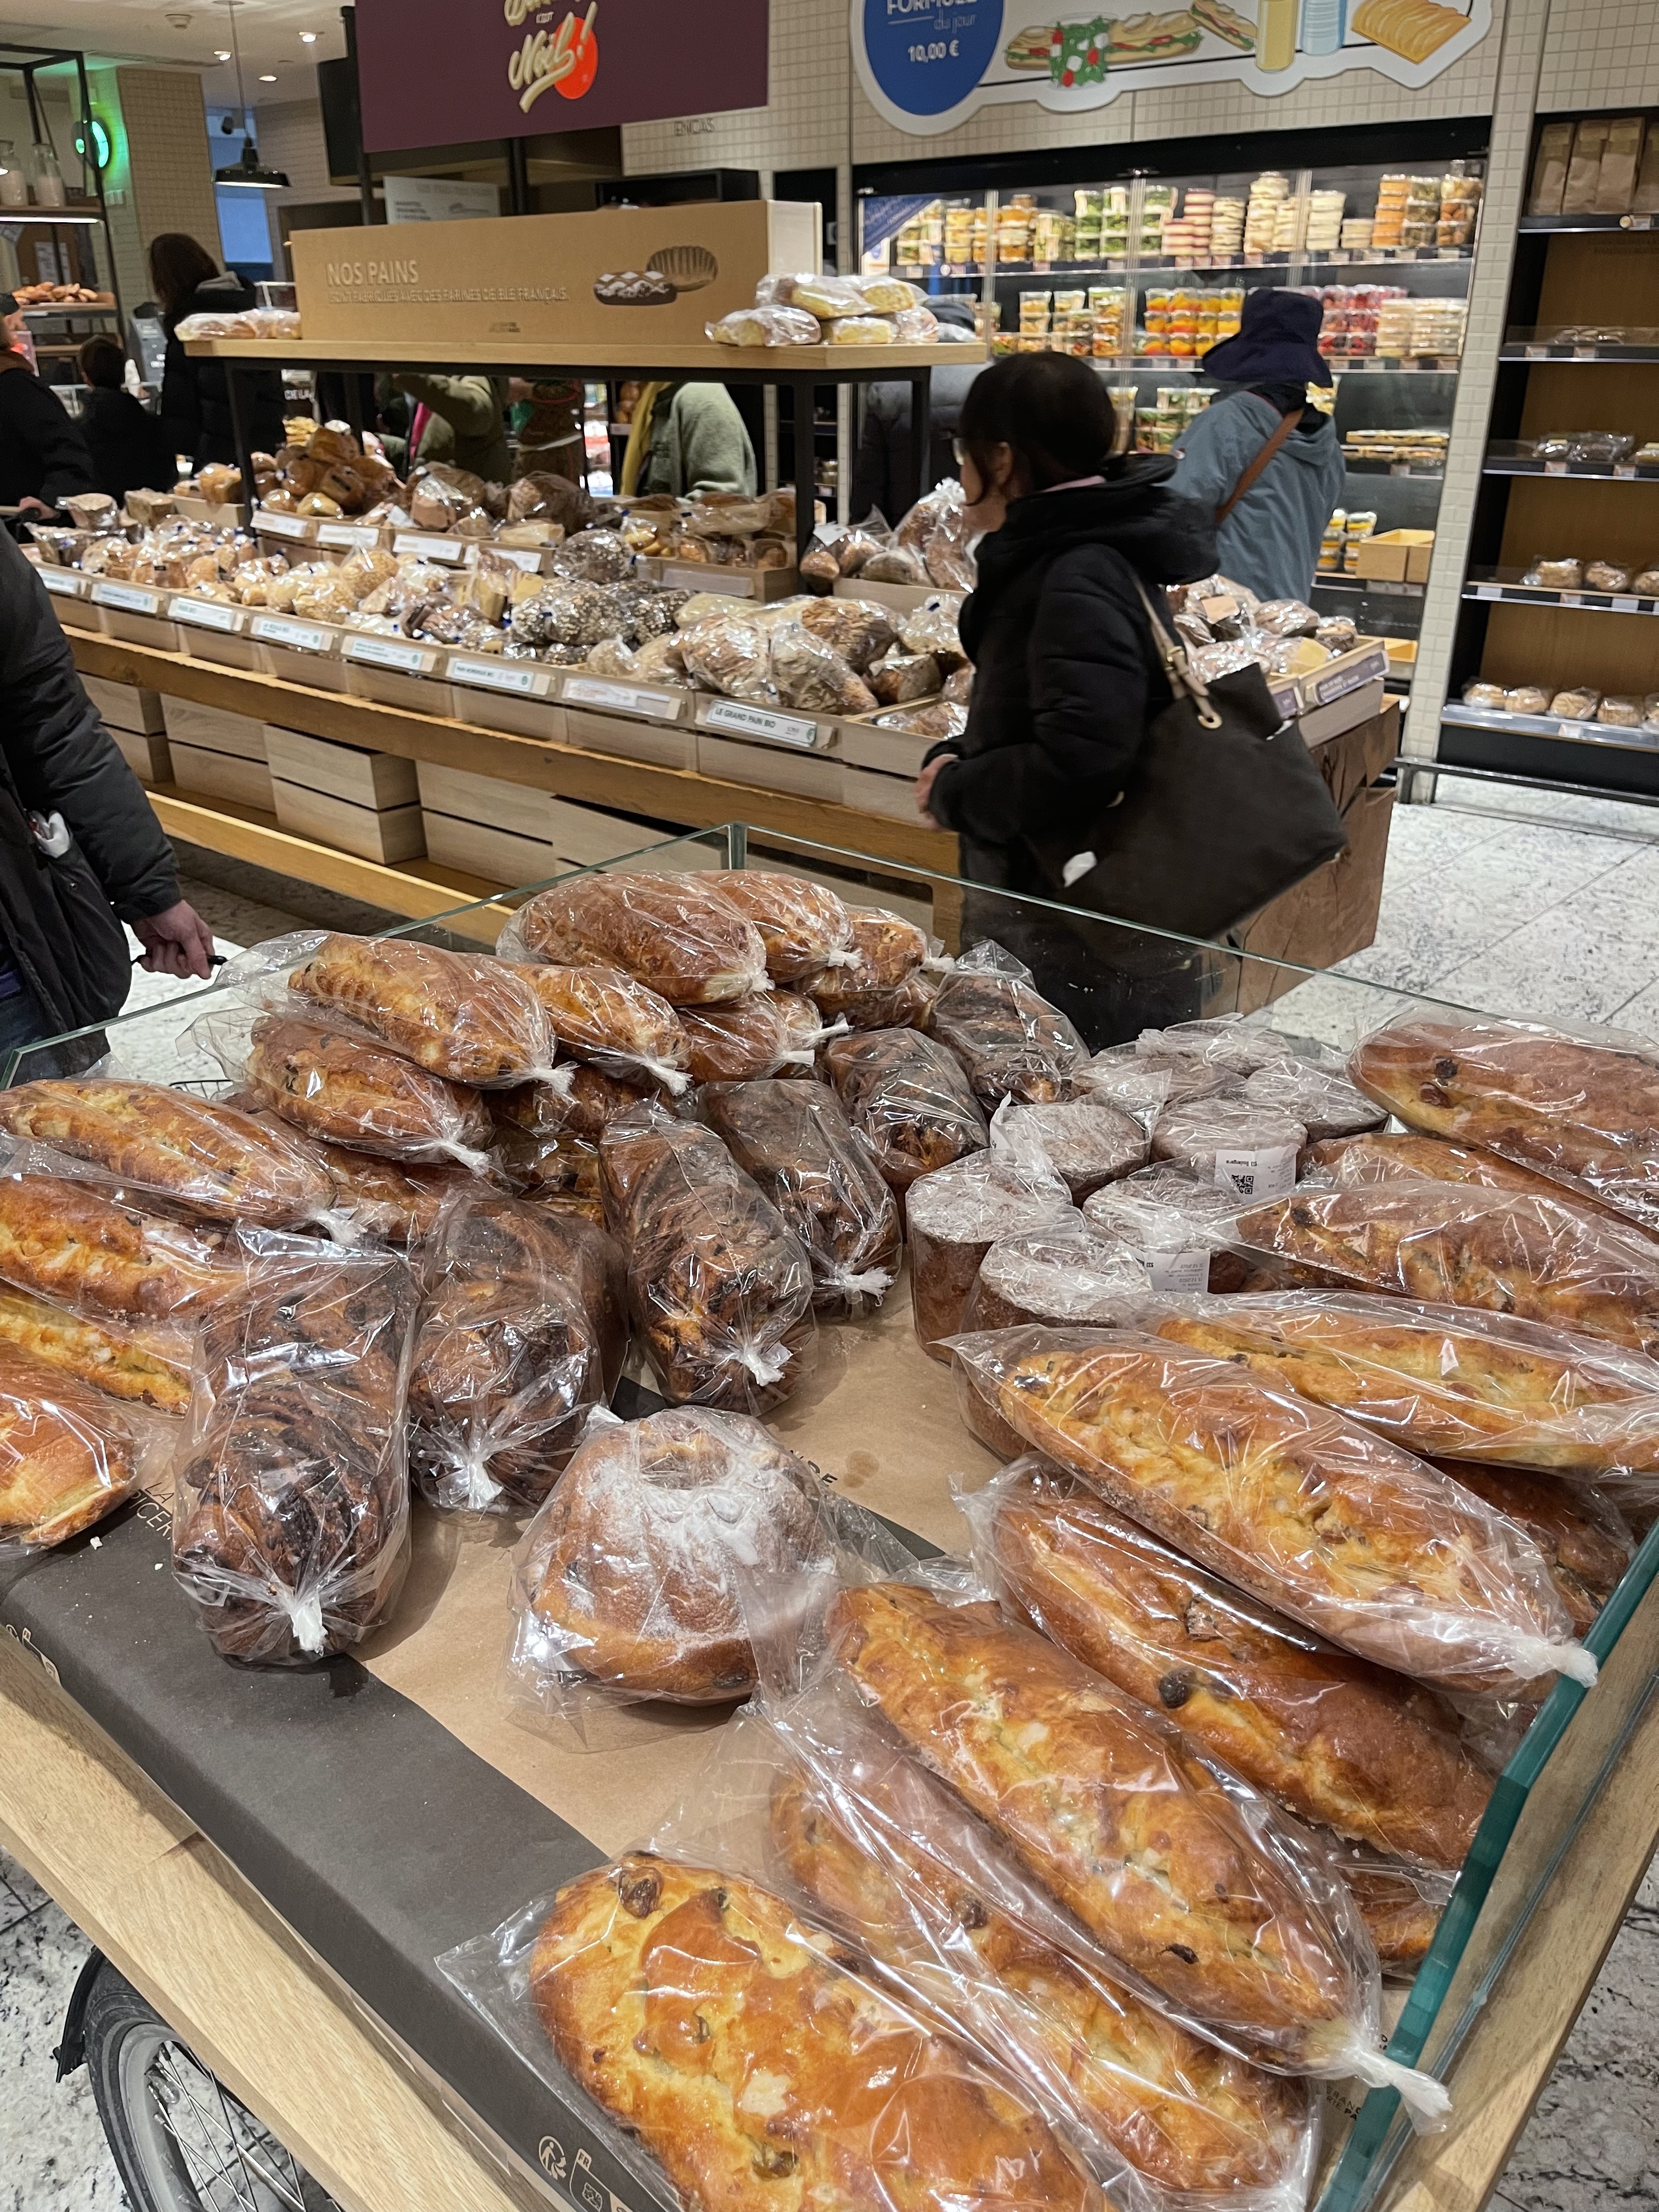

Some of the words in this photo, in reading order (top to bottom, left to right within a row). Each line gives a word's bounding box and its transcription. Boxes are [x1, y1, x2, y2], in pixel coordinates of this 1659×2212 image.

[933, 8, 951, 30] du
[951, 14, 977, 34] jour
[908, 42, 947, 63] 10,00
[949, 40, 960, 57] €
[674, 117, 715, 136] ENCAS
[326, 262, 363, 287] NOS
[366, 259, 419, 286] PAINS
[724, 709, 747, 721] GRAND
[748, 715, 763, 726] PAIN
[764, 719, 776, 729] BIO
[144, 1482, 174, 1504] LA
[578, 2151, 590, 2168] FR
